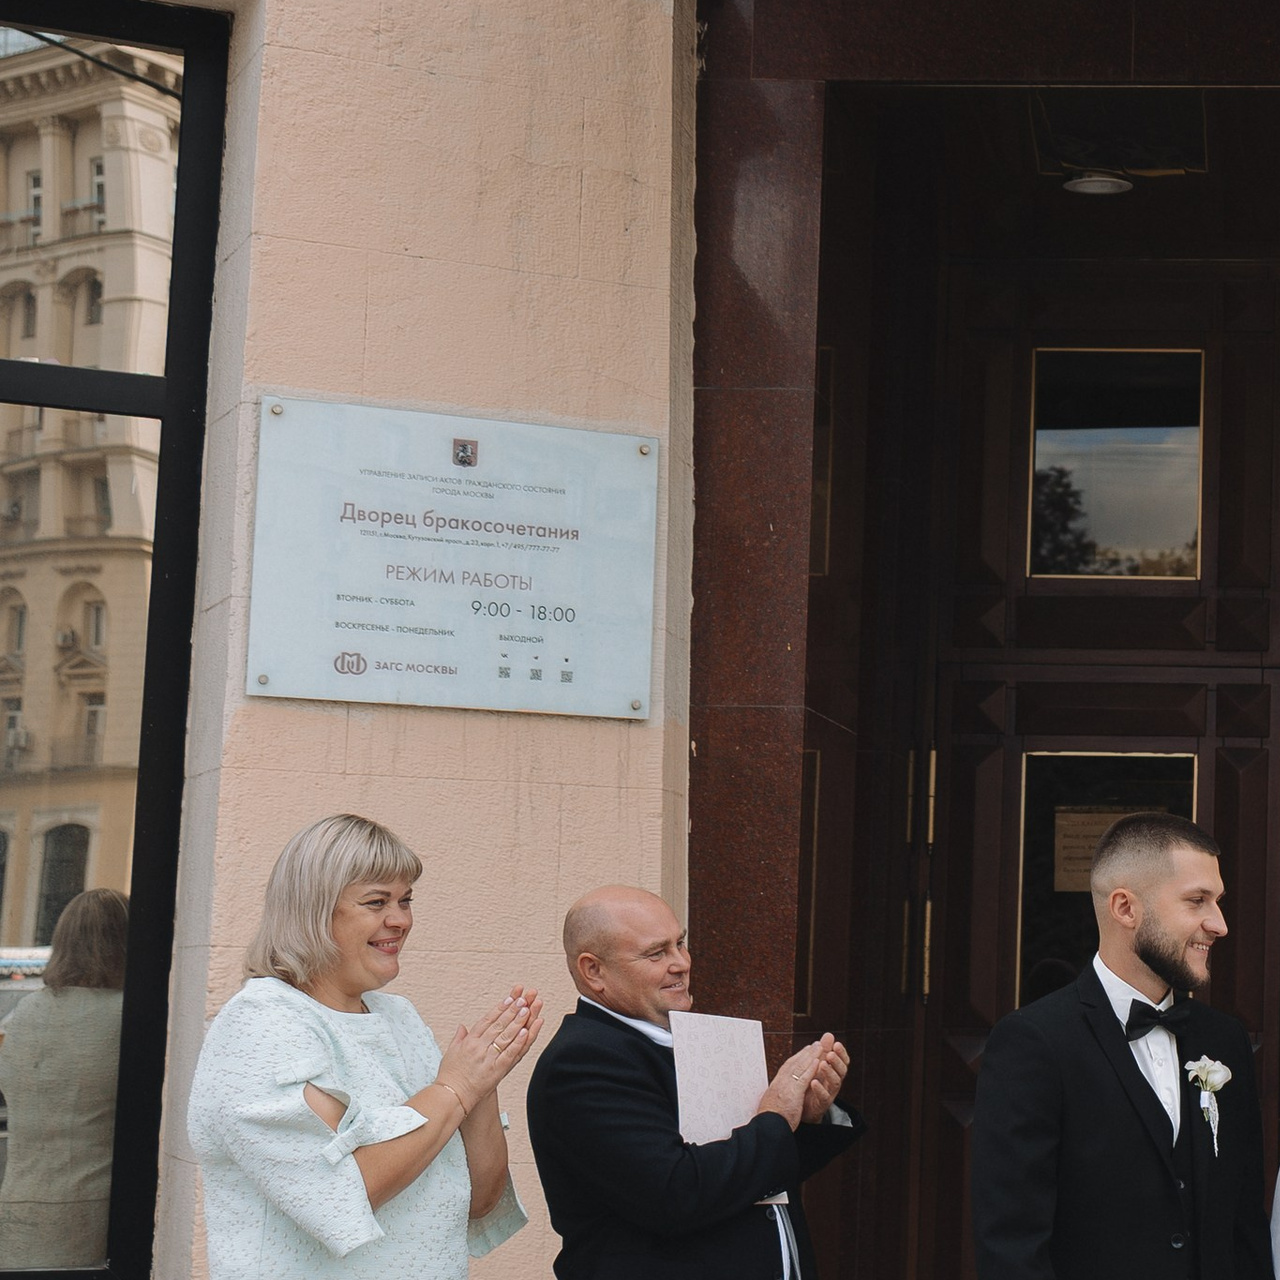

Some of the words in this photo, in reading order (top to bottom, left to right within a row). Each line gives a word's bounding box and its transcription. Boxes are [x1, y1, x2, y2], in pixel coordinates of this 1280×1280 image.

[359, 468, 405, 480] УПРАВЛЕНИЕ
[407, 473, 438, 483] ЗАПИСИ
[440, 476, 462, 485] АКТОВ
[465, 479, 521, 490] ГРАЖДАНСКОГО
[523, 485, 566, 495] СОСТОЯНИЯ
[432, 486, 461, 496] ГОРОДА
[463, 490, 494, 499] МОСКВЫ
[340, 502, 417, 529] Дворец
[423, 509, 580, 541] бракосочетания
[386, 564, 455, 584] РЕЖИМ
[462, 571, 532, 591] РАБОТЫ
[336, 594, 373, 604] ВТОРНИК
[380, 597, 415, 606] СУББОТА
[471, 600, 510, 617] 9:00
[530, 605, 576, 623] 18:00
[335, 621, 390, 632] ВОСКРЕСЕНЬЕ
[396, 625, 455, 637] ПОНЕДЕЛЬНИК
[499, 634, 544, 644] ВЫХОДНОЙ
[374, 661, 403, 671] ЗАГС
[405, 663, 458, 675] МОСКВЫ
